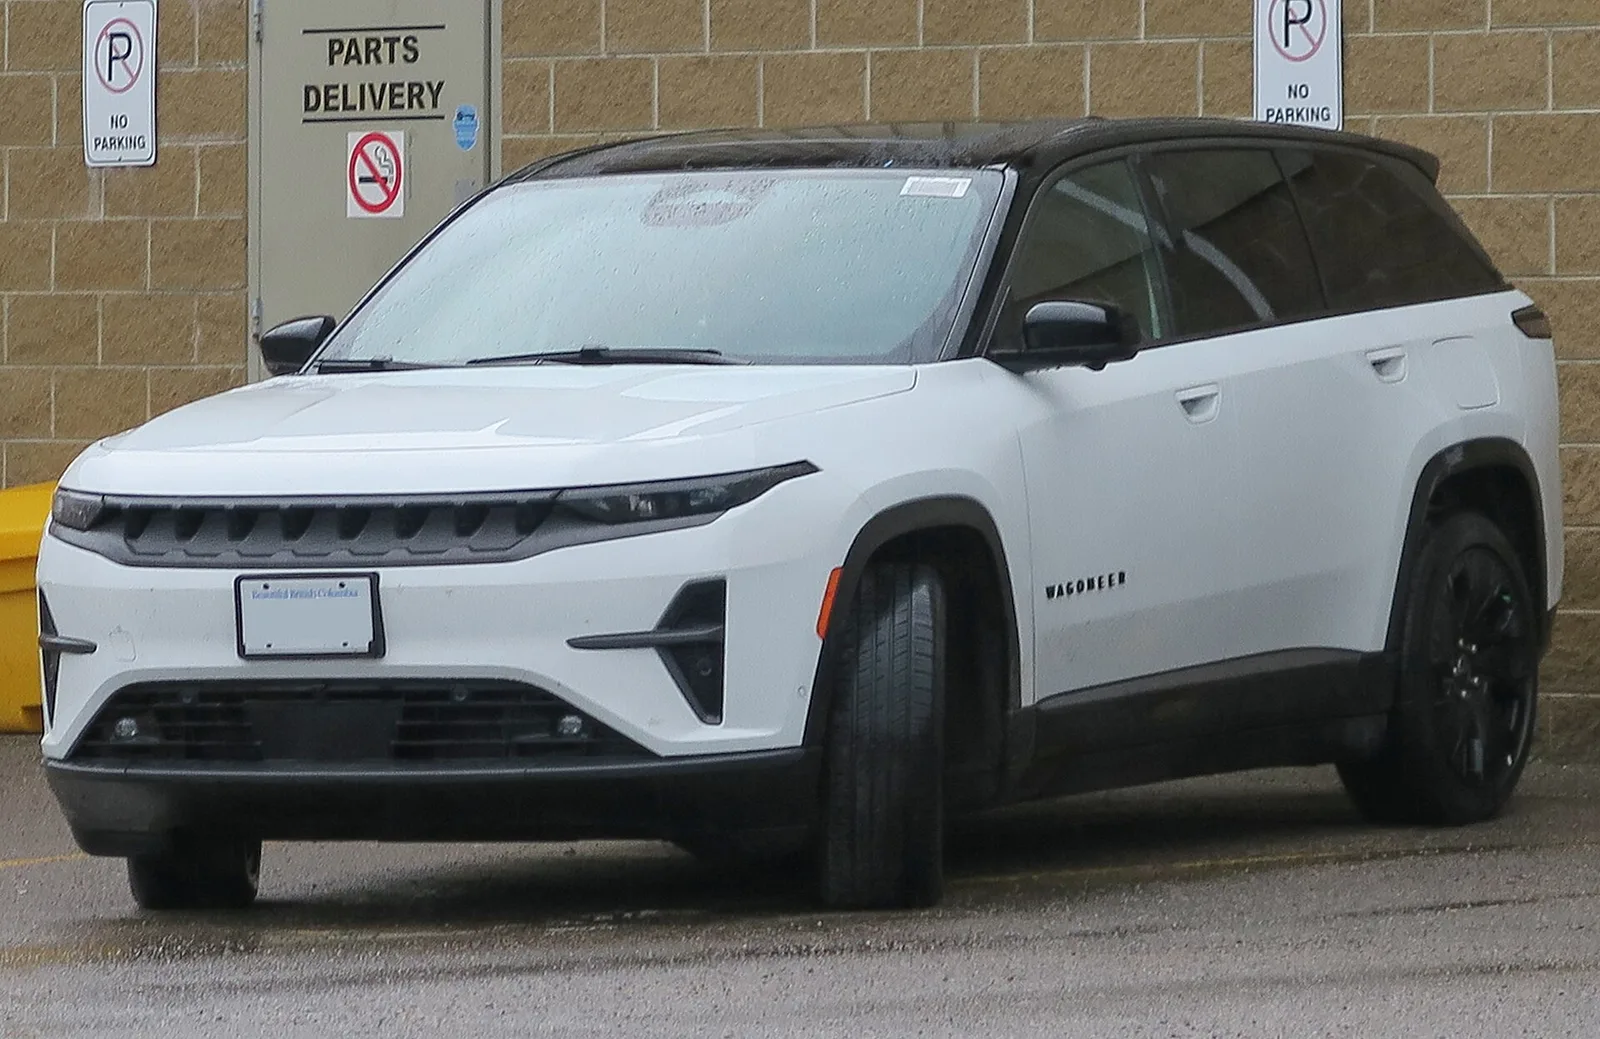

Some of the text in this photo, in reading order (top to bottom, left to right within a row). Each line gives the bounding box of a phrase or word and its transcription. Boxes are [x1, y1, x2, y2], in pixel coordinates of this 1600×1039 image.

[1284, 0, 1312, 48] P
[108, 32, 132, 81] P
[328, 35, 419, 66] PARTS
[303, 80, 445, 112] DELIVERY
[1288, 84, 1309, 99] NO
[110, 114, 128, 129] NO
[1266, 106, 1331, 123] PARKING
[94, 135, 146, 151] PARKING
[1045, 571, 1126, 600] WAGONEER
